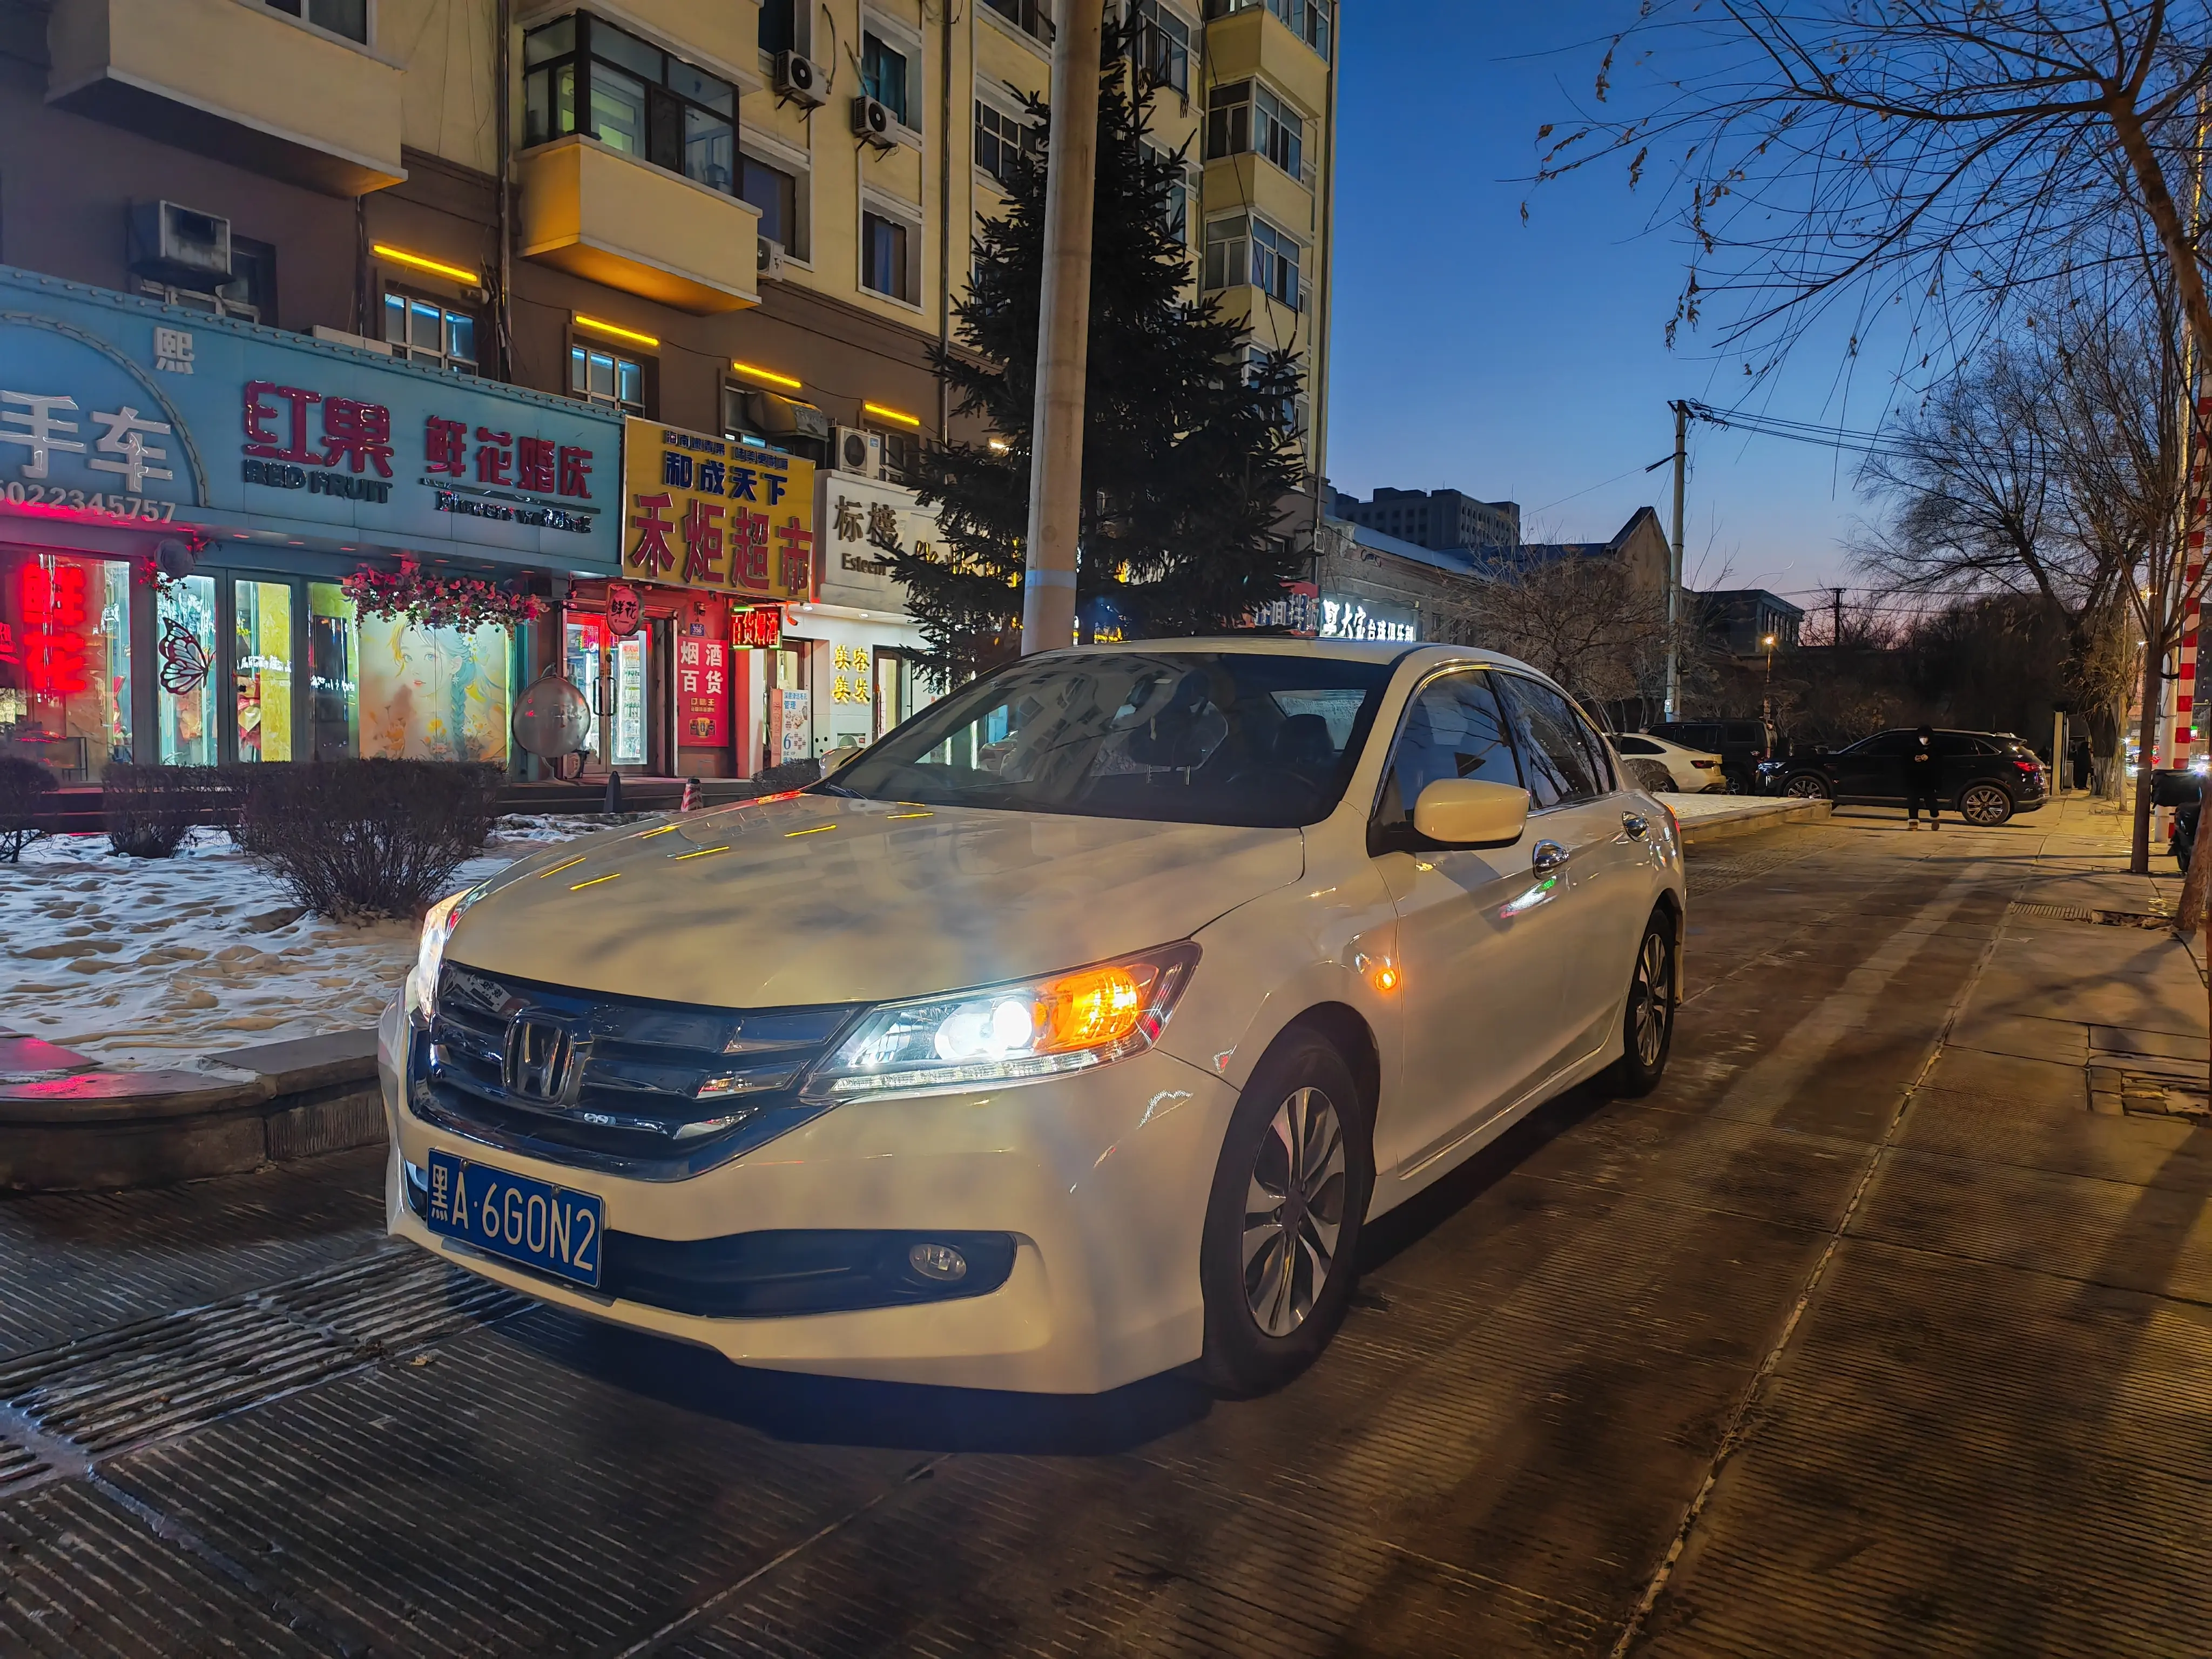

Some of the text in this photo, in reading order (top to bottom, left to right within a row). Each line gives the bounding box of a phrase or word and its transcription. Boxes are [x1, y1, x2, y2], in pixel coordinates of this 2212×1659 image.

[243, 380, 394, 477] 红果
[425, 414, 593, 498] 鲜花婚庆
[665, 450, 788, 506] 和成天下
[632, 492, 812, 595] 禾炬超市
[680, 641, 722, 667] 烟酒
[680, 670, 724, 694] 百货
